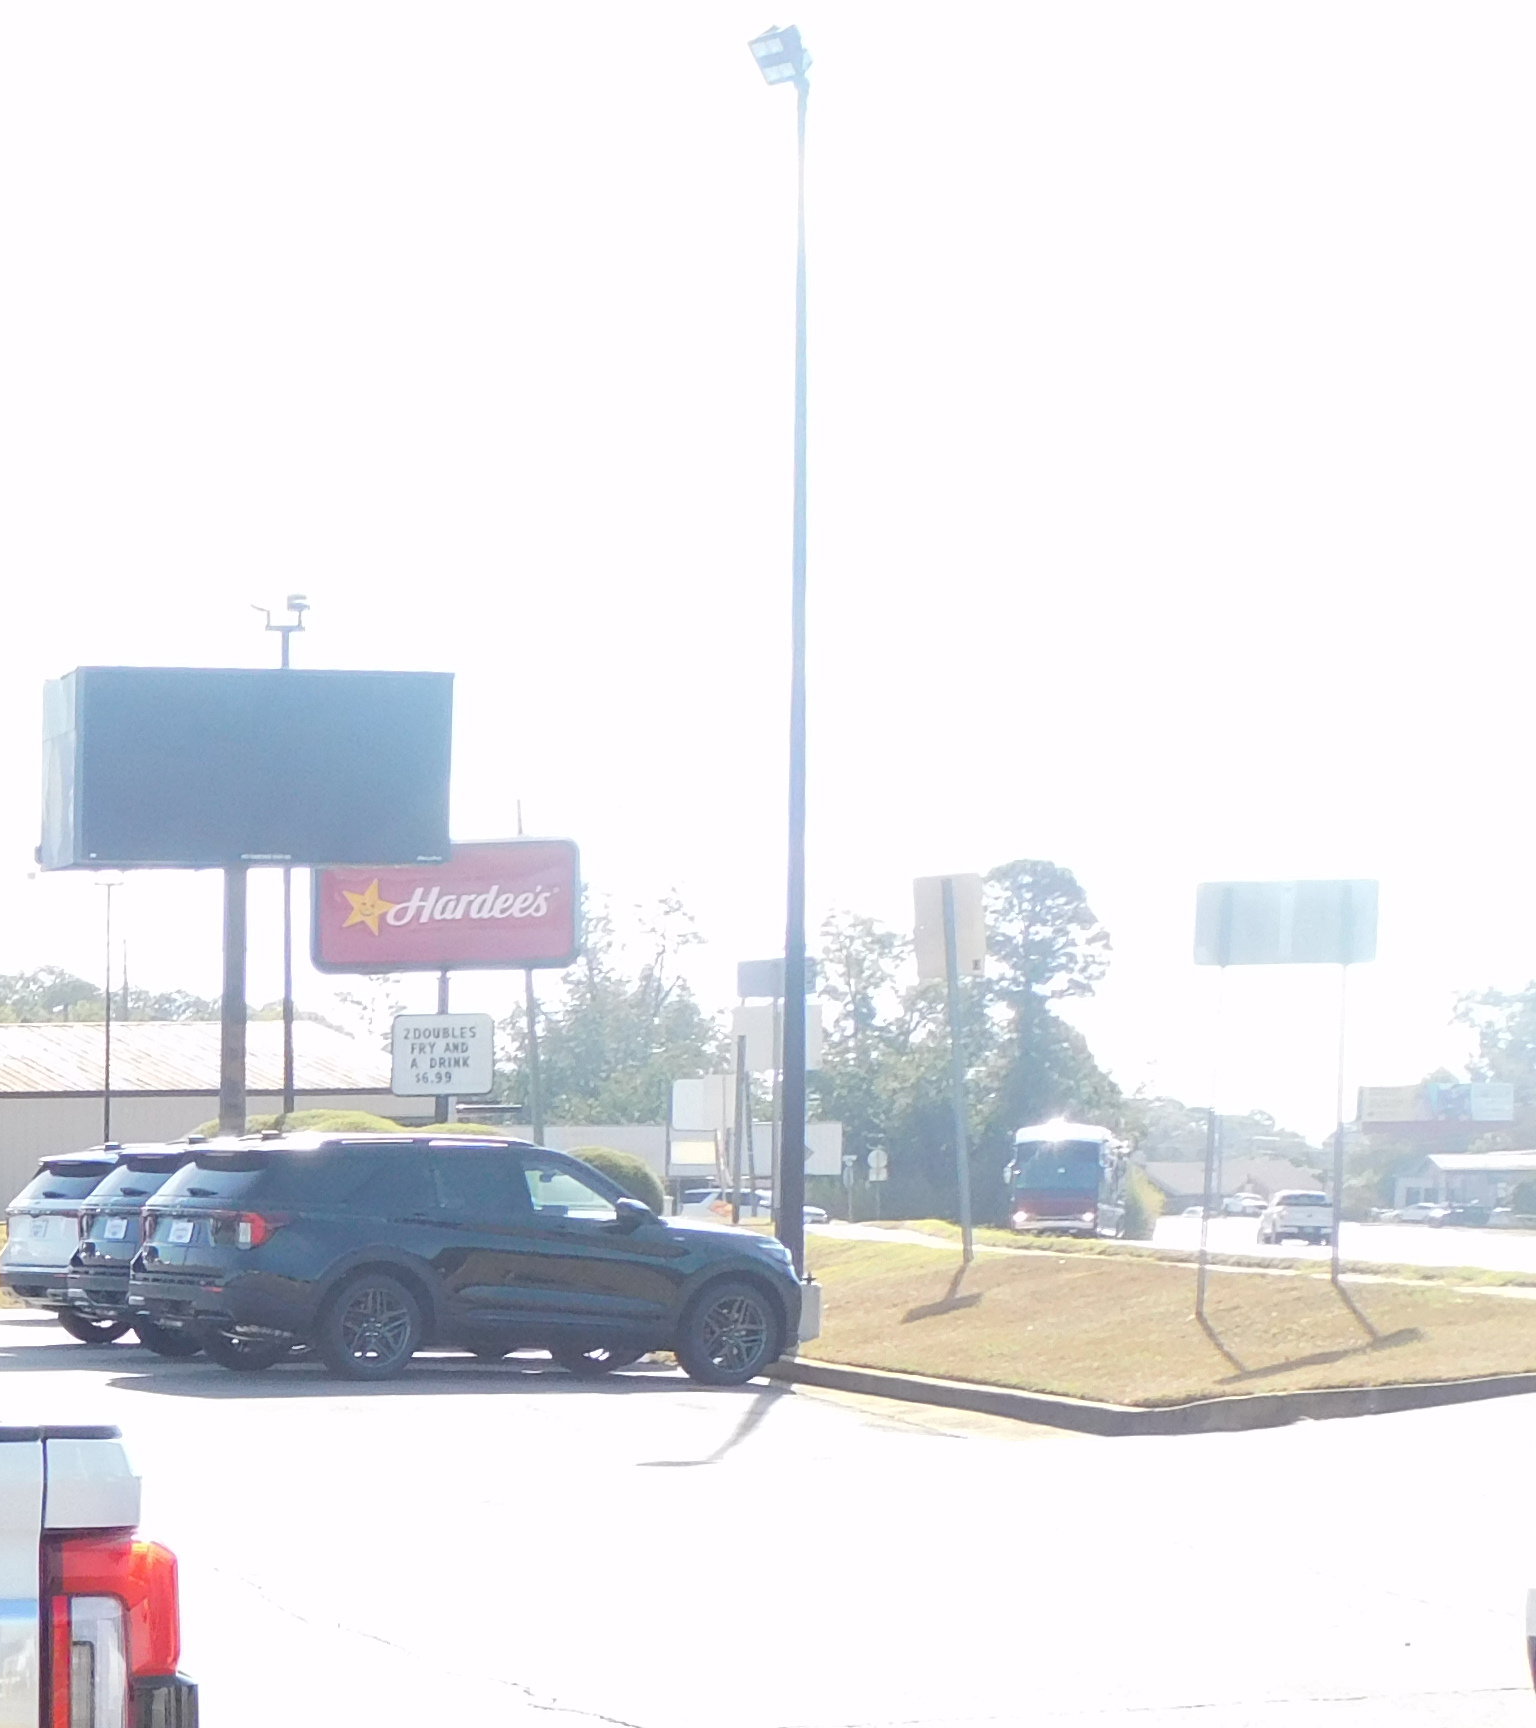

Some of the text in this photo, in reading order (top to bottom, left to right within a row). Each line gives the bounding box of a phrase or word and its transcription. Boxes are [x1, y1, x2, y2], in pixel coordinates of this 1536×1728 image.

[385, 884, 550, 927] Hardee's
[410, 1042, 469, 1055] FRY AND
[410, 1056, 470, 1069] A DRINK
[415, 1071, 452, 1084] $6.99
